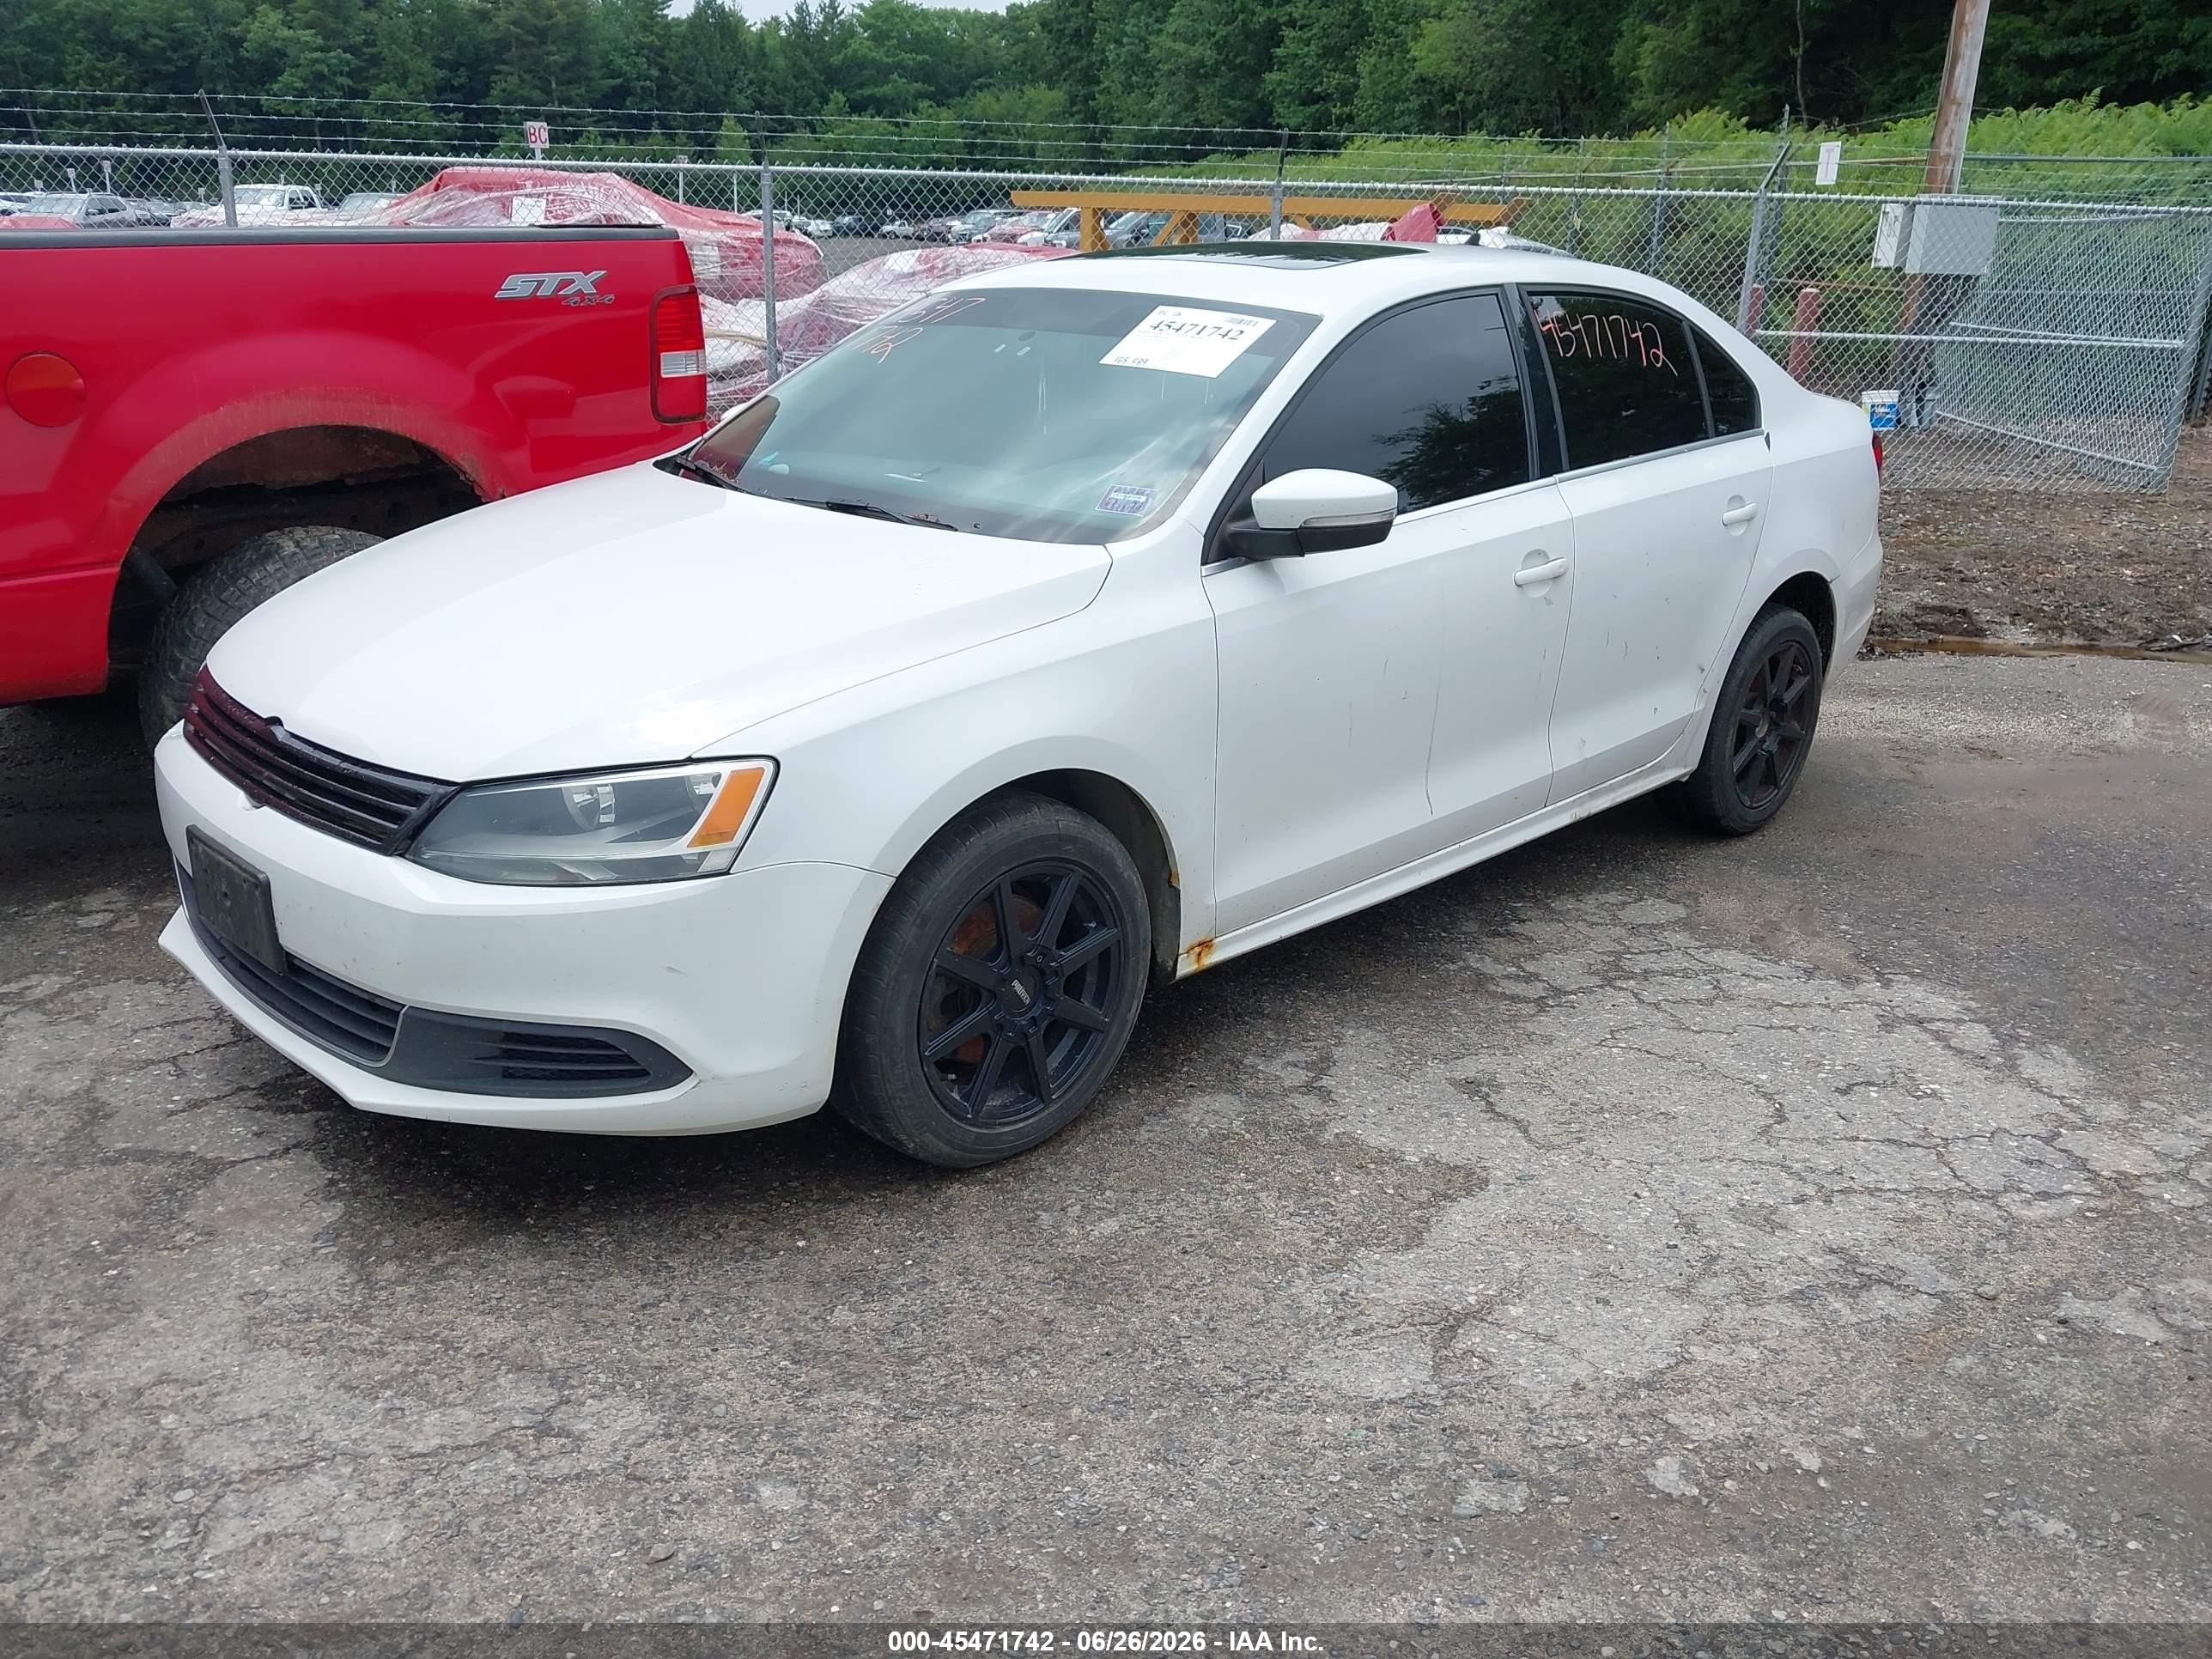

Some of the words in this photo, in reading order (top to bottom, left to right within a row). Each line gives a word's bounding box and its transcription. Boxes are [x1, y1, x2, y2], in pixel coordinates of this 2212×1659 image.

[528, 125, 547, 144] BC
[495, 270, 606, 298] STX
[1150, 320, 1244, 340] 45471742
[1534, 308, 1678, 377] 45471742
